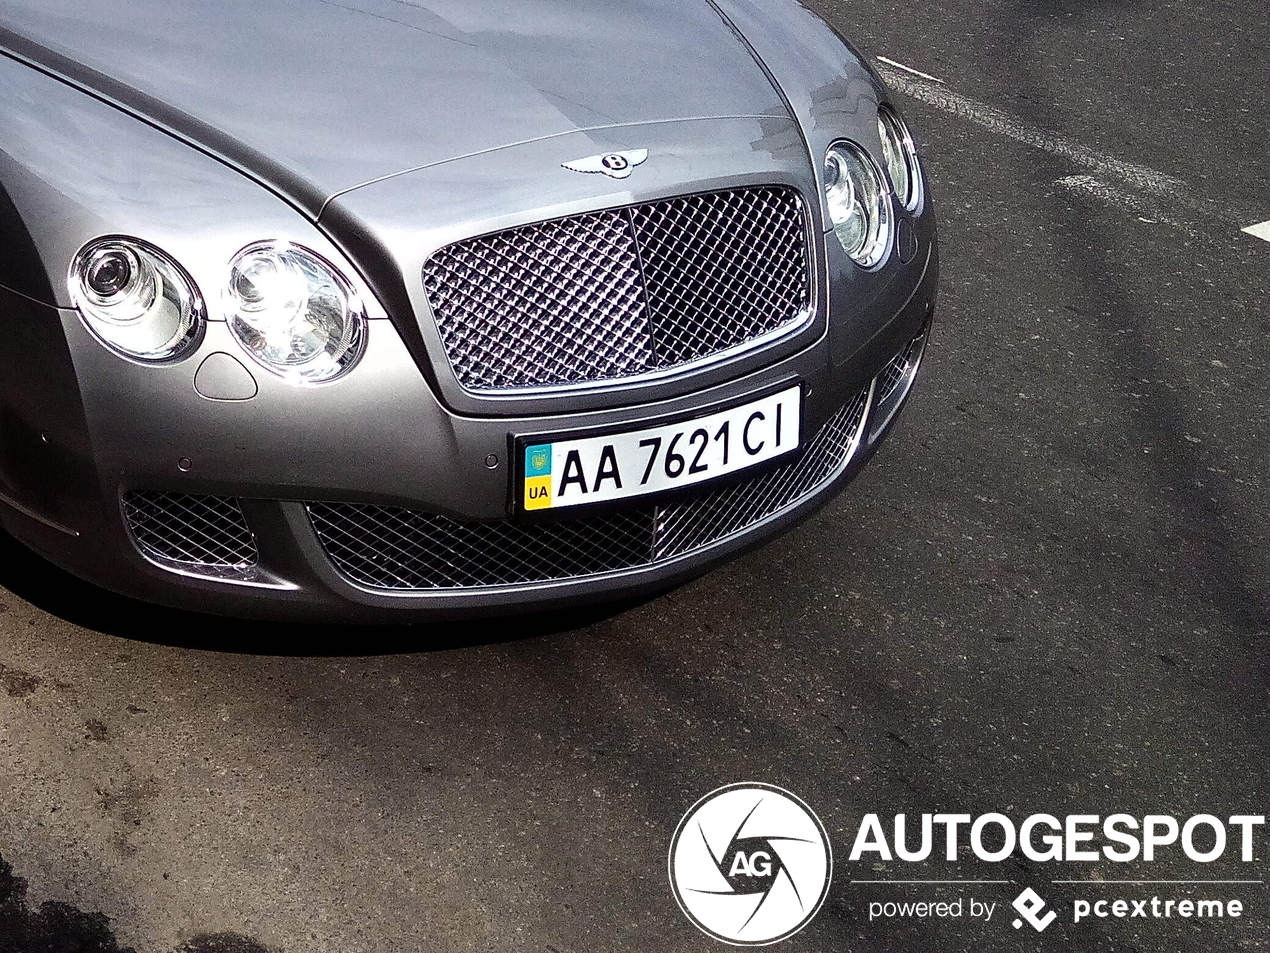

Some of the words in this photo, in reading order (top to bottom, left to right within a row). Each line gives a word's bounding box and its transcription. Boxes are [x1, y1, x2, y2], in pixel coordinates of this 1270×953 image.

[558, 445, 622, 497] AA
[638, 420, 730, 486] 7621
[742, 403, 783, 456] CI
[529, 486, 548, 500] UA
